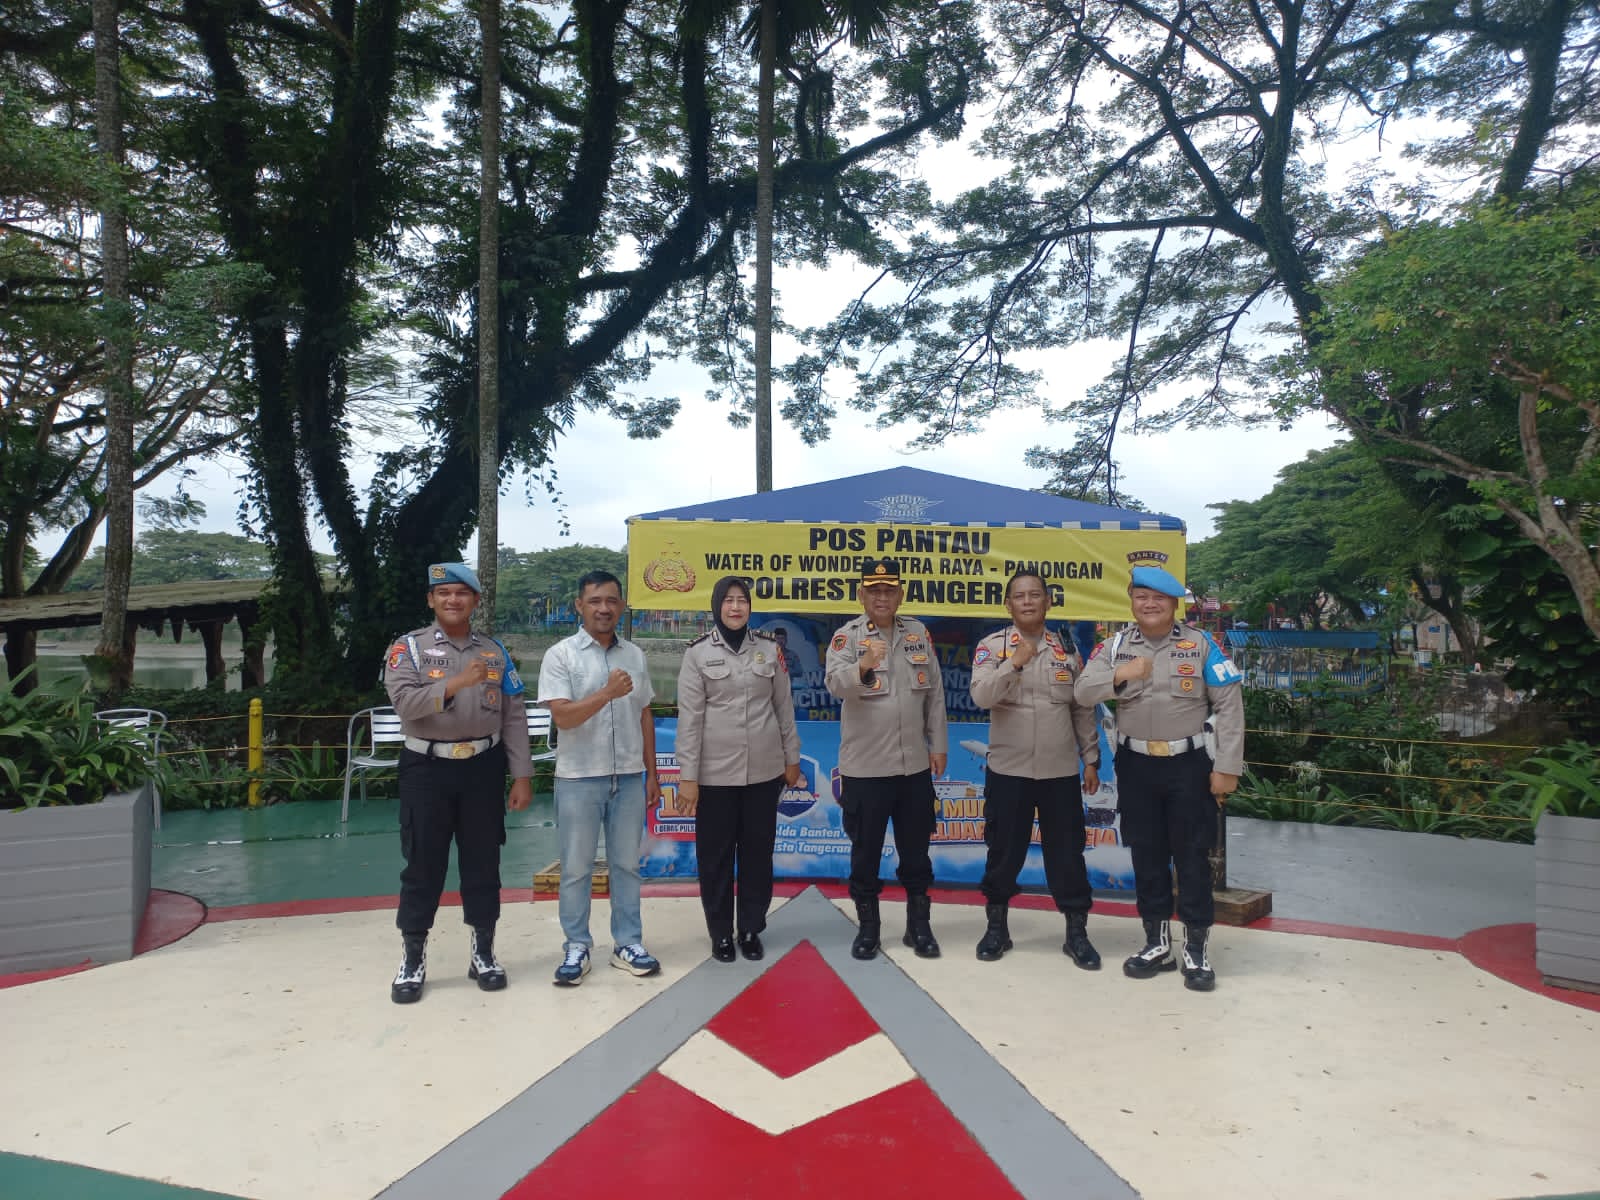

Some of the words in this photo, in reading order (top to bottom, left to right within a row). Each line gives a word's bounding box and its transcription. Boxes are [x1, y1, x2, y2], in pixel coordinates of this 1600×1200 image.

[809, 528, 866, 551] POS
[876, 528, 991, 555] PANTAU
[705, 553, 764, 571] WATER
[769, 554, 793, 572] OF
[798, 555, 873, 573] WONDE
[881, 556, 934, 574] TRA
[939, 558, 984, 576] RAYA
[1004, 560, 1103, 580] PANONGAN
[742, 577, 862, 601] OLREST
[899, 580, 1065, 607] ANGERG
[1170, 651, 1201, 659] POLRI
[798, 841, 852, 855] Tangeran
